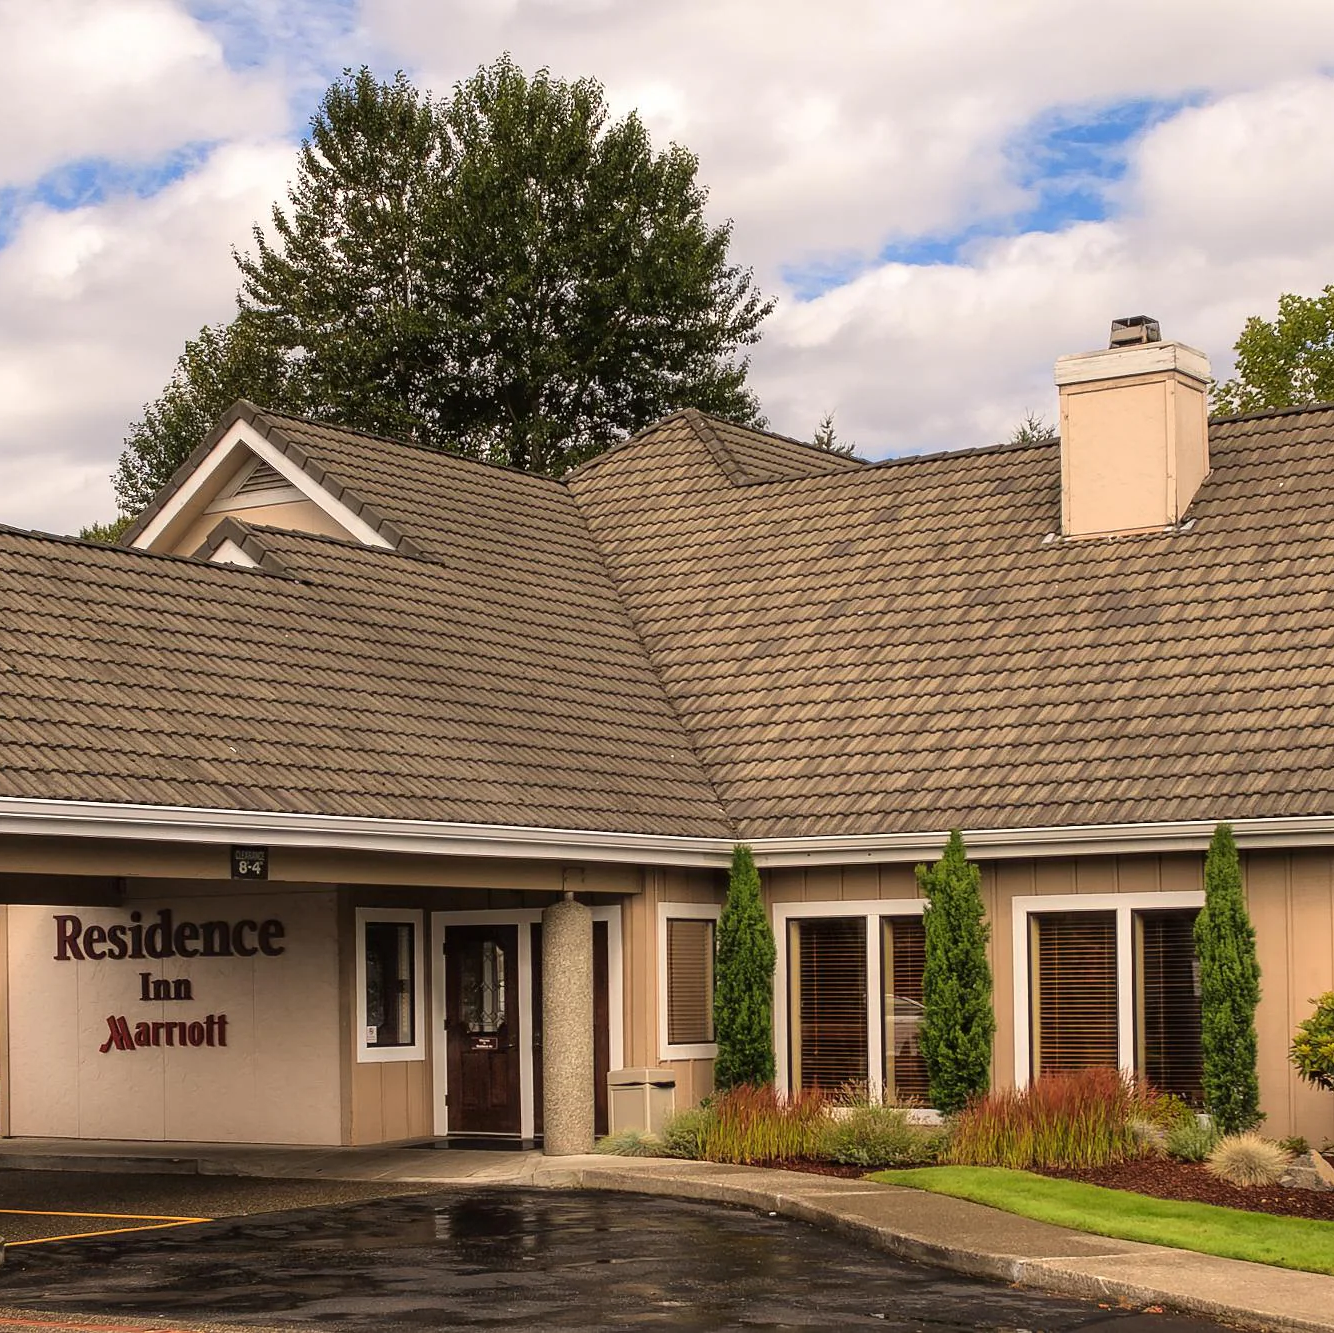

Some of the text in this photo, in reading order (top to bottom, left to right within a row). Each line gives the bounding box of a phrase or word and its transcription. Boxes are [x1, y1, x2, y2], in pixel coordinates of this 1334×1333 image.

[53, 909, 286, 961] Residence
[139, 973, 195, 1001] Inn
[99, 1014, 229, 1053] Marriott
